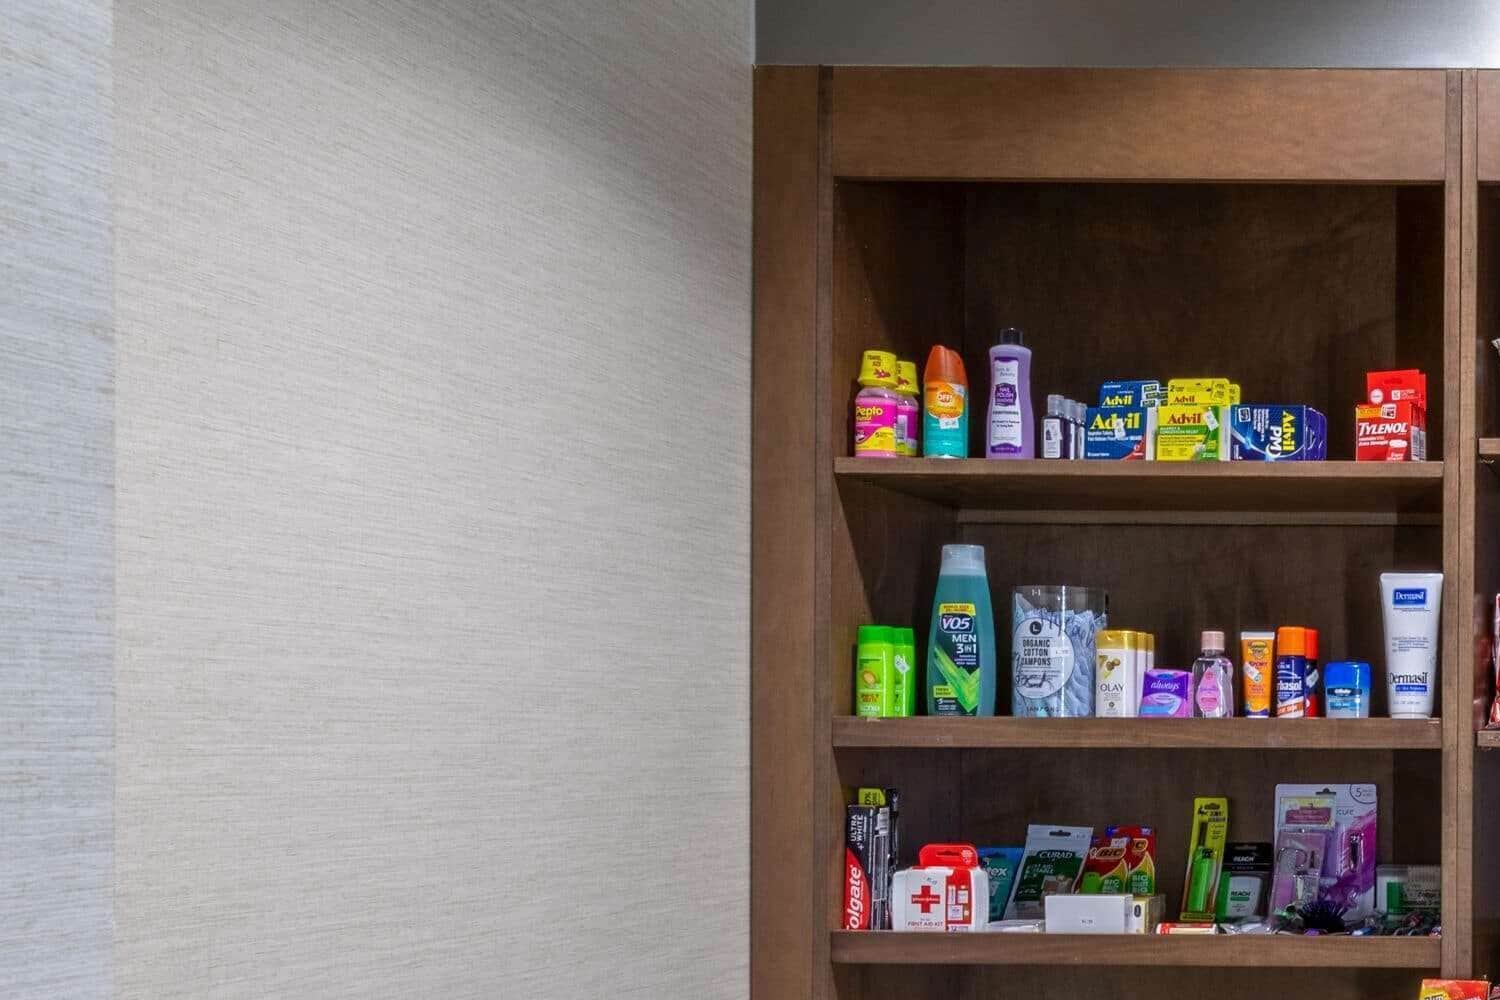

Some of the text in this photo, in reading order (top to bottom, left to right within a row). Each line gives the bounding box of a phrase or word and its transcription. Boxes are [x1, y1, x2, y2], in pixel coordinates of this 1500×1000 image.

[1102, 395, 1132, 406] Advil
[1174, 395, 1195, 403] Advil
[1167, 413, 1202, 425] Advil
[1281, 411, 1296, 451] Advil
[1358, 422, 1409, 437] TYLENOL
[1270, 425, 1282, 451] PM
[1395, 591, 1425, 601] Dermasil
[942, 617, 970, 630] VO5
[952, 634, 977, 643] MEN
[1022, 639, 1050, 648] ORGANIC
[956, 644, 964, 654] 3
[1023, 648, 1048, 657] COTTON
[1020, 658, 1051, 666] TAMPONS
[1389, 671, 1428, 684] Dermasil
[1100, 683, 1125, 693] OLAY
[856, 814, 864, 842] WHITE
[1039, 850, 1073, 860] CURAD
[1100, 848, 1122, 857] BIC
[847, 866, 863, 931] olgate
